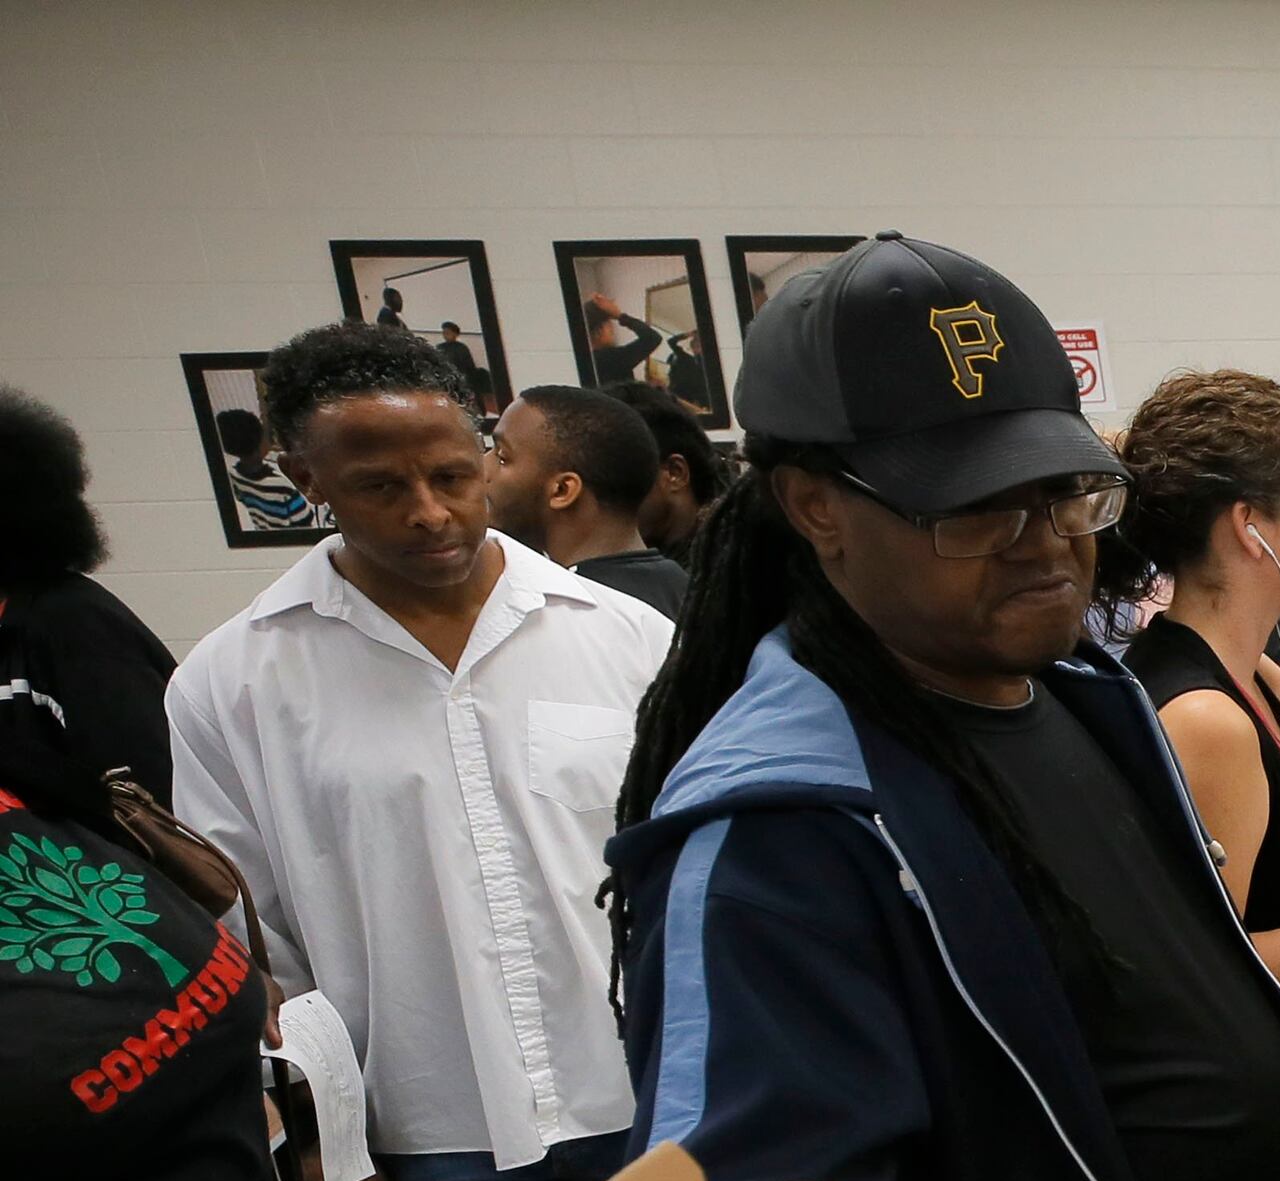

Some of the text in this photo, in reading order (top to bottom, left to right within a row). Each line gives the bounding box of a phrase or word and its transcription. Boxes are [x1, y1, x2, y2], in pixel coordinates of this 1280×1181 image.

[1067, 332, 1088, 341] CELL
[930, 300, 1005, 399] P
[1078, 341, 1095, 349] USE
